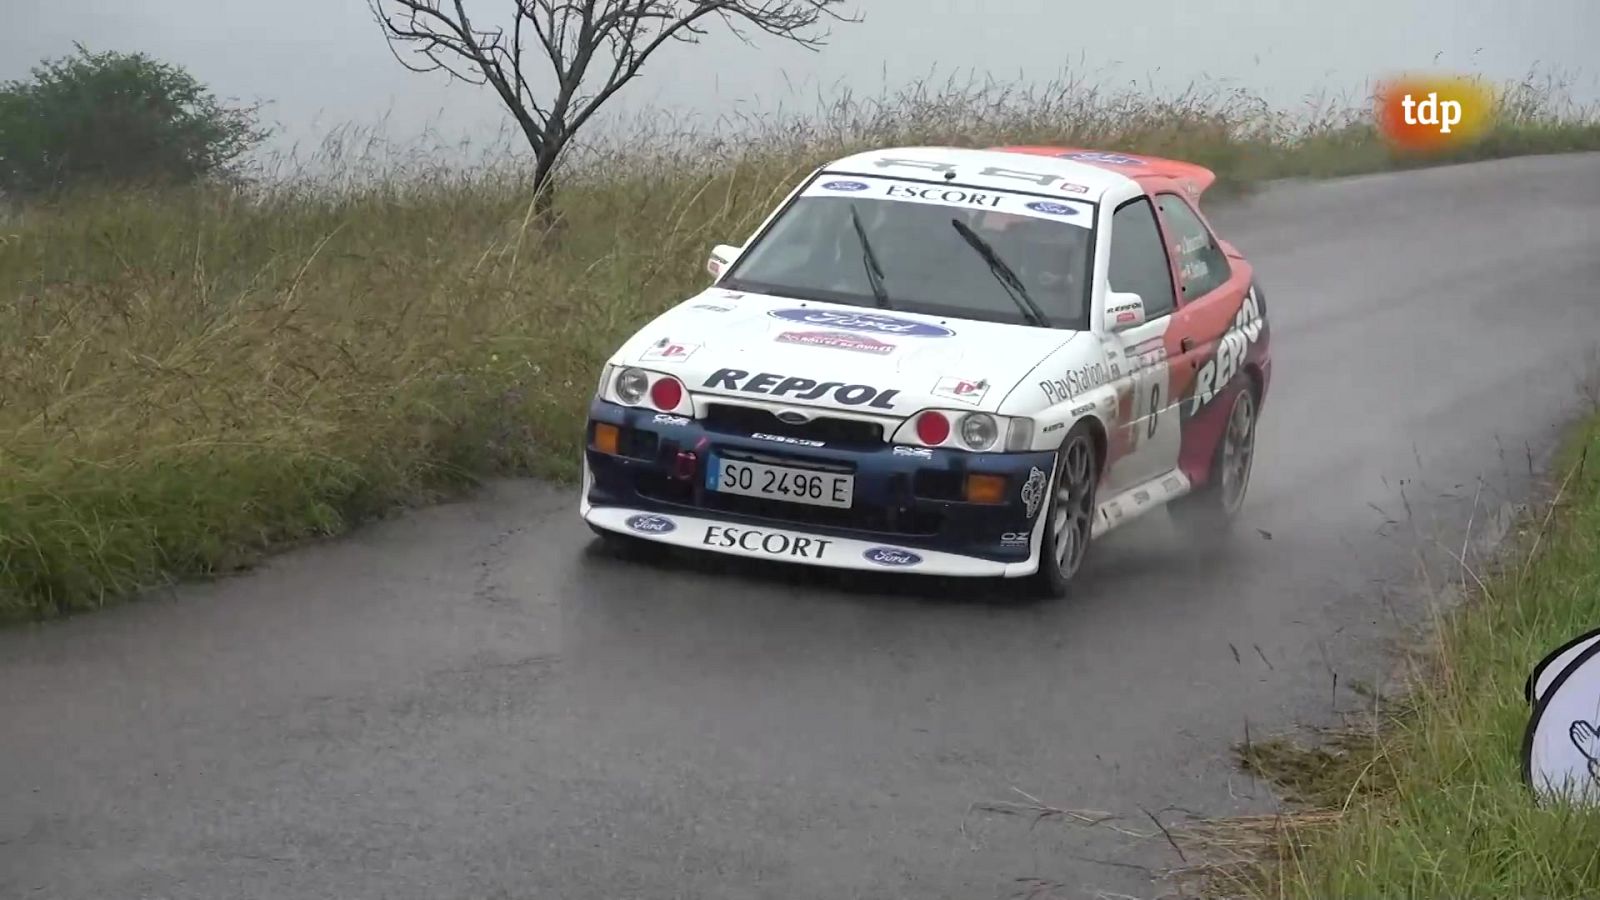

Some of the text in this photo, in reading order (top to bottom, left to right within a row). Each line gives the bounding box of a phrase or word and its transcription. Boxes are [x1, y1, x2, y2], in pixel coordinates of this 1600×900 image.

[886, 184, 1006, 207] ESCORT
[804, 310, 918, 332] Ford
[703, 368, 901, 409] REPSOL
[1039, 362, 1104, 405] PlayStation
[723, 464, 848, 502] SO 2496 E
[703, 526, 833, 559] ESCORT
[873, 549, 910, 564] Ford
